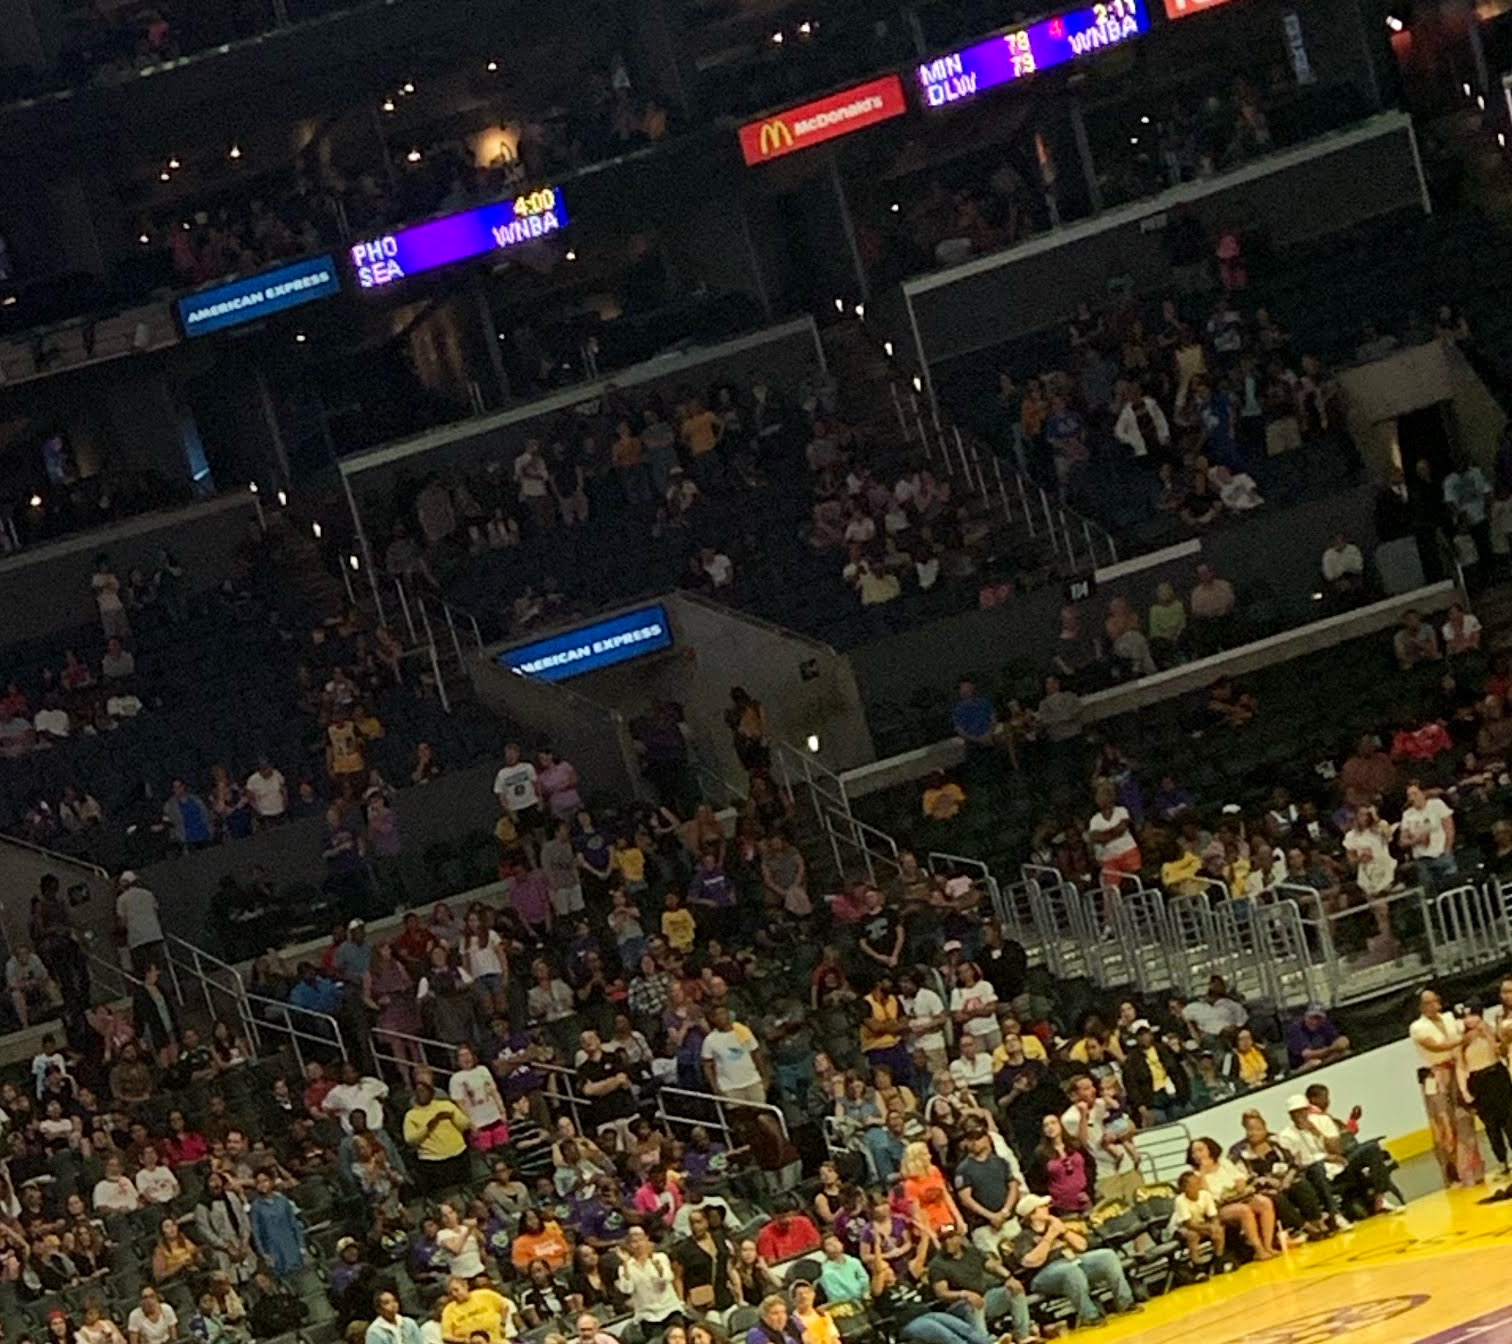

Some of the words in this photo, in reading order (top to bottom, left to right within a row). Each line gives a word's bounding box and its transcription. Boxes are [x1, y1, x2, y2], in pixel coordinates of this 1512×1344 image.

[1069, 18, 1138, 54] WNBA
[921, 54, 961, 85] MIN
[794, 93, 882, 137] McDonald's
[514, 187, 555, 217] 4:00
[492, 211, 559, 249] WNBA
[352, 236, 398, 267] PHO
[358, 258, 405, 288] SEA
[188, 290, 264, 324] AMERICAN
[266, 270, 330, 300] EXPRESS
[594, 623, 662, 655] EXPRESS
